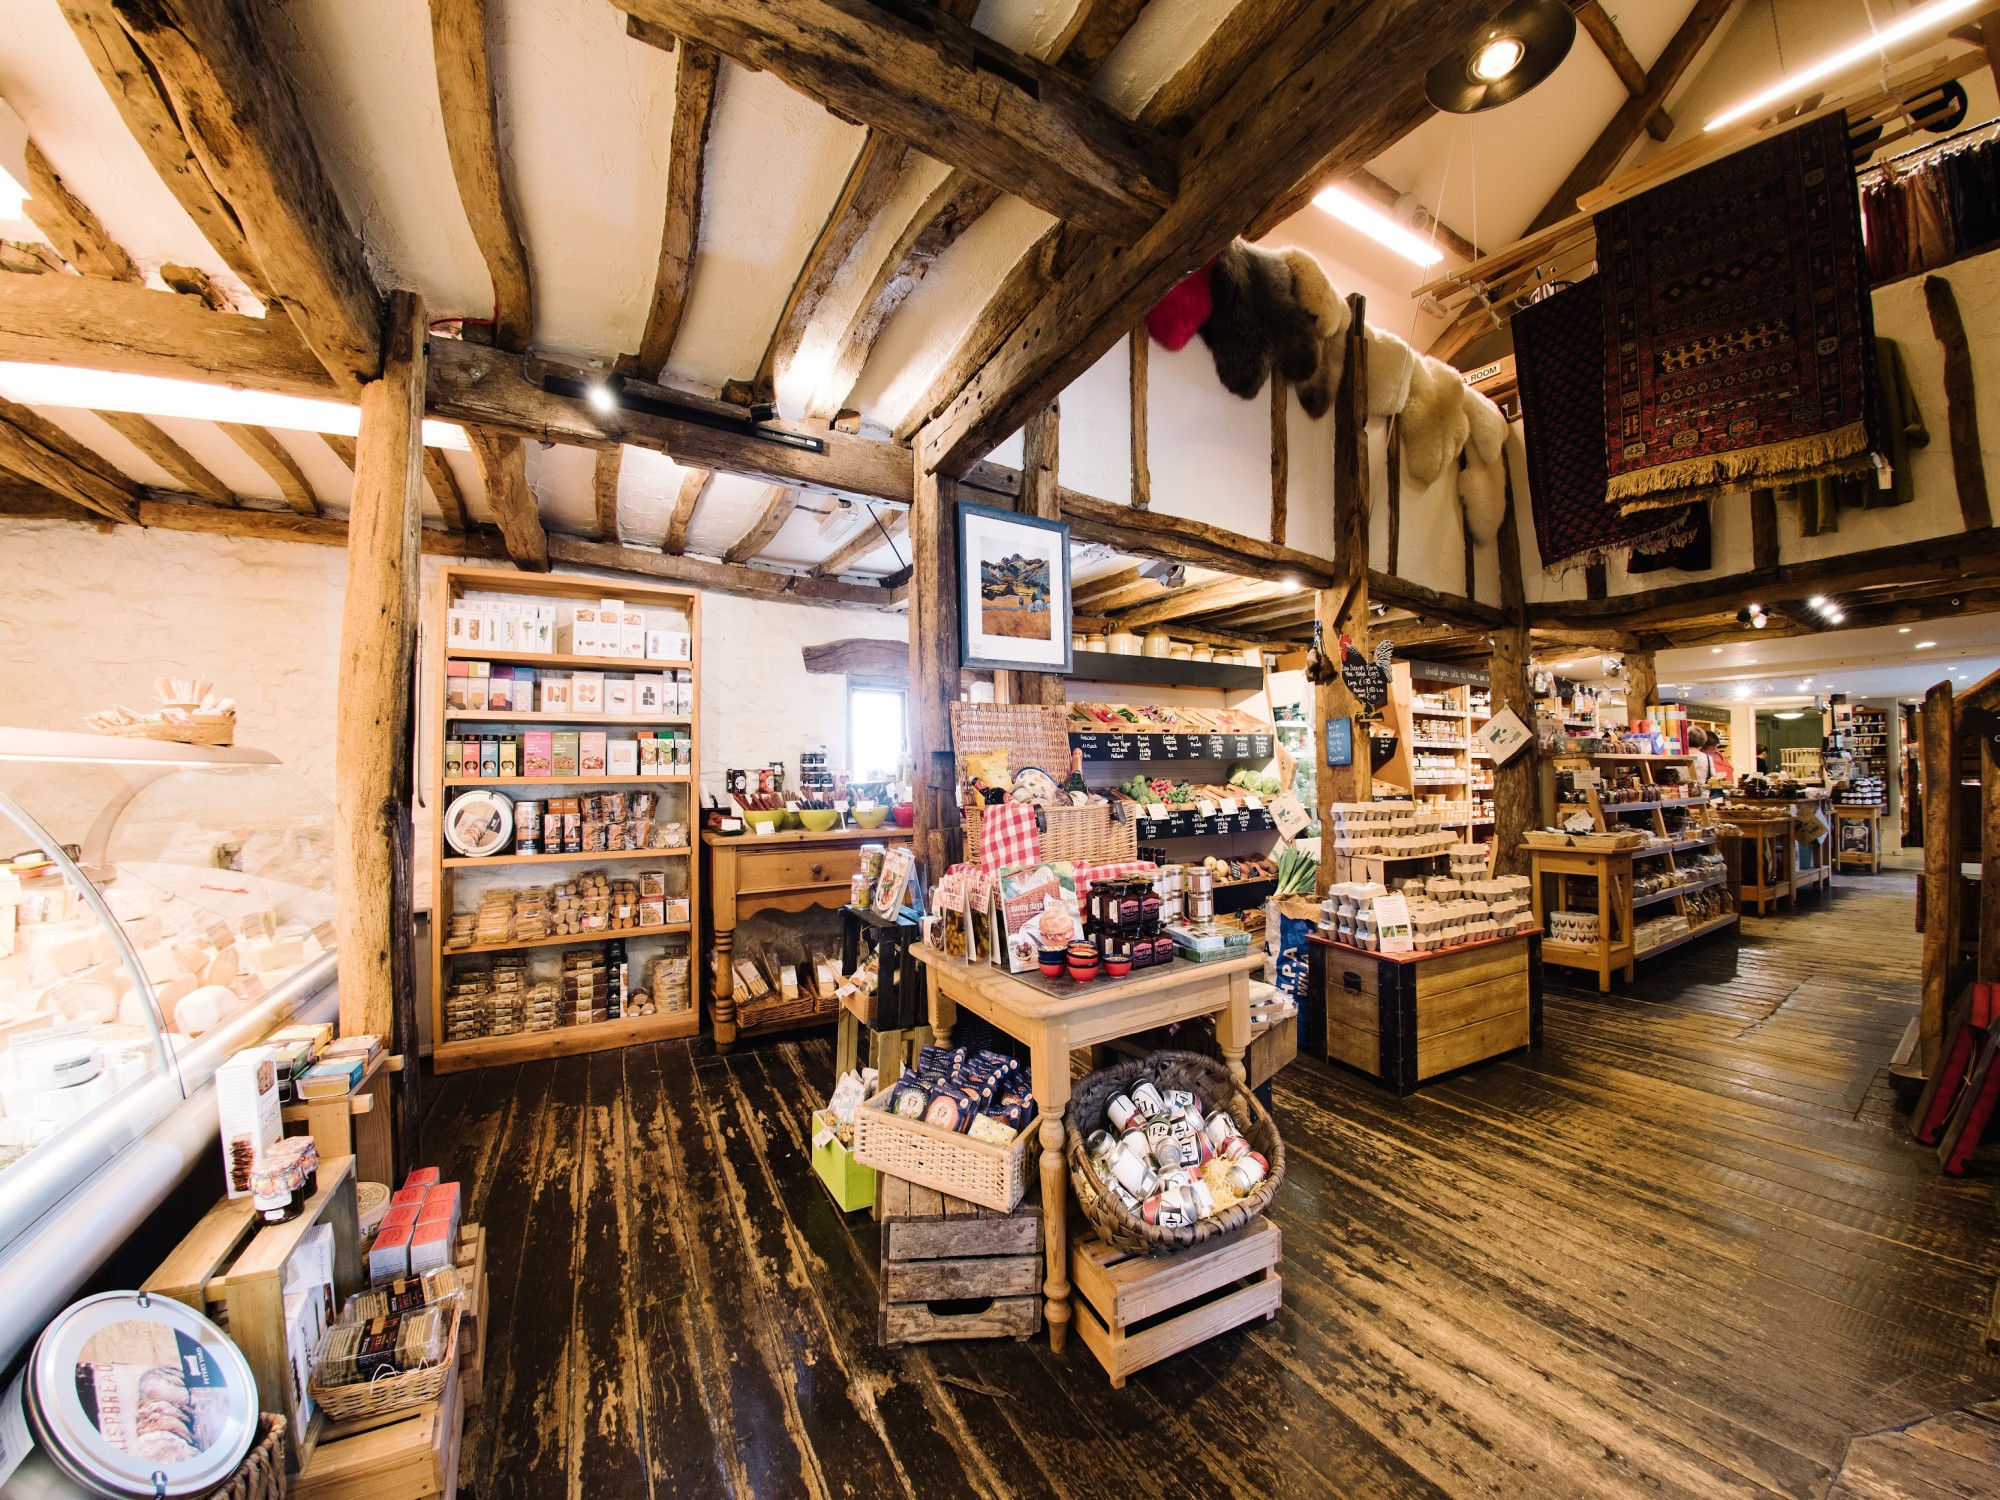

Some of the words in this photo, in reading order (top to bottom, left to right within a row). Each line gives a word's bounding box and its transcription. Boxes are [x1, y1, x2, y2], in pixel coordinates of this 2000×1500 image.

[1470, 366, 1497, 381] ROOM
[1440, 670, 1449, 679] you
[1080, 733, 1097, 741] Avocado
[1010, 904, 1029, 912] sunny
[1029, 901, 1043, 911] days
